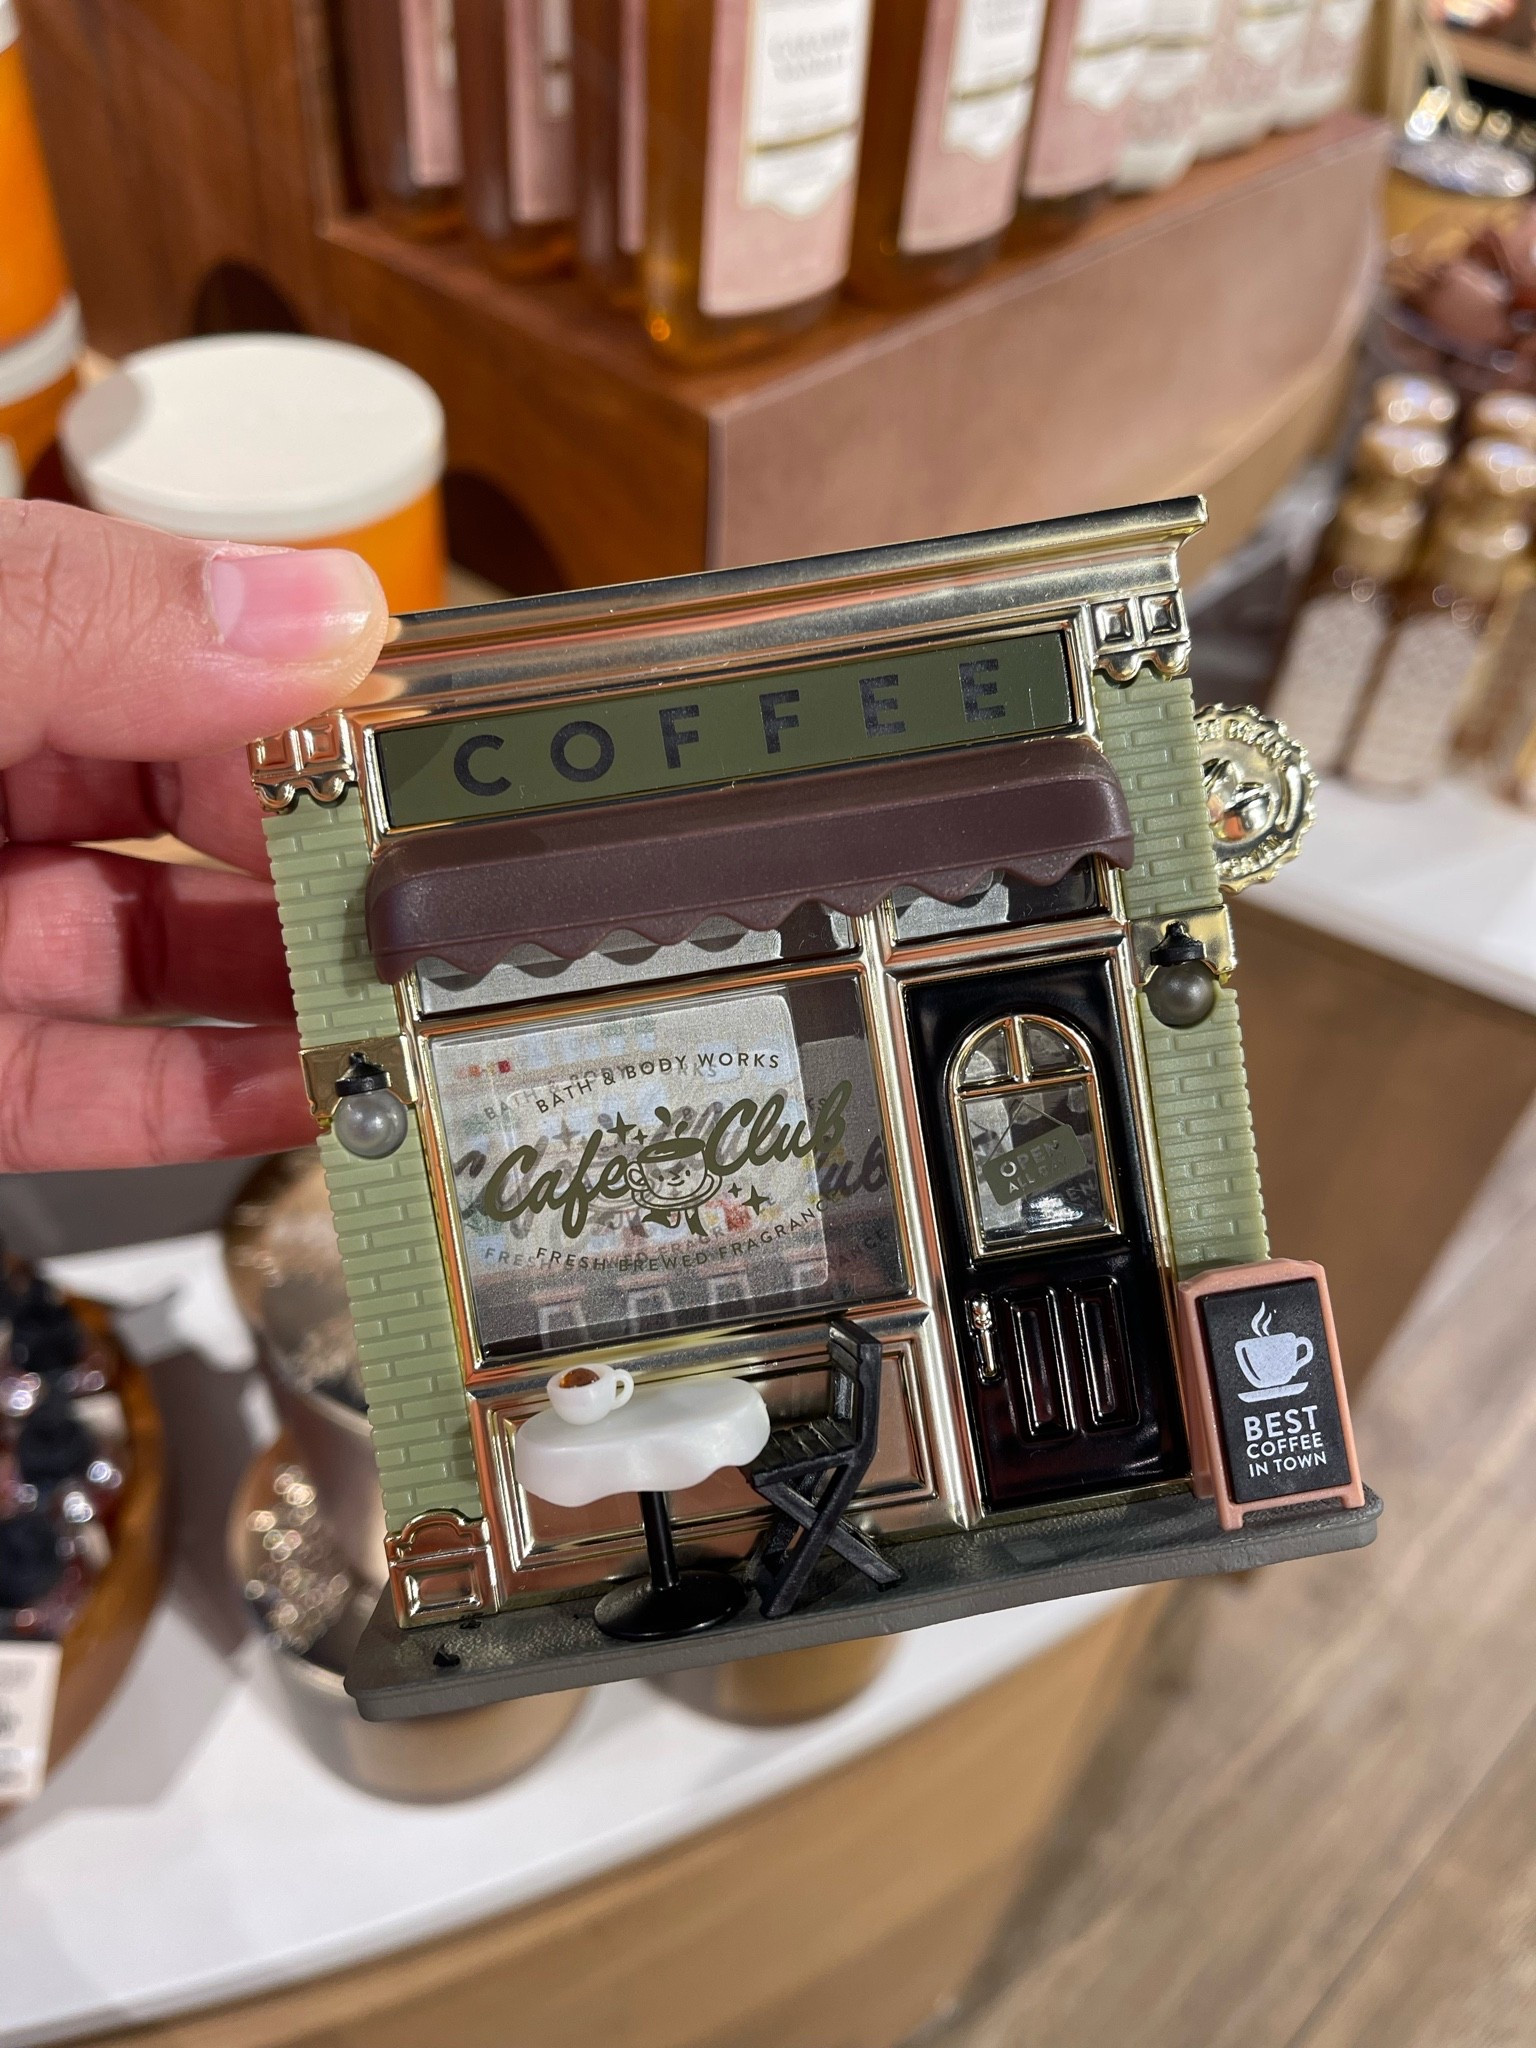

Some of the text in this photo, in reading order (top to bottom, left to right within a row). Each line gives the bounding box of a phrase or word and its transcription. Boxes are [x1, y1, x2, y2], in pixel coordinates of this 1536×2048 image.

[453, 658, 1006, 797] COFFEE
[535, 1052, 780, 1113] BATH & BODY WORKS
[484, 1080, 853, 1239] Cafe Club
[536, 1247, 606, 1270] FRESH
[618, 1252, 708, 1272] BREWED
[1243, 1405, 1318, 1442] BEST
[1246, 1432, 1324, 1459] COFFEE
[1249, 1451, 1327, 1477] IN TOWN
